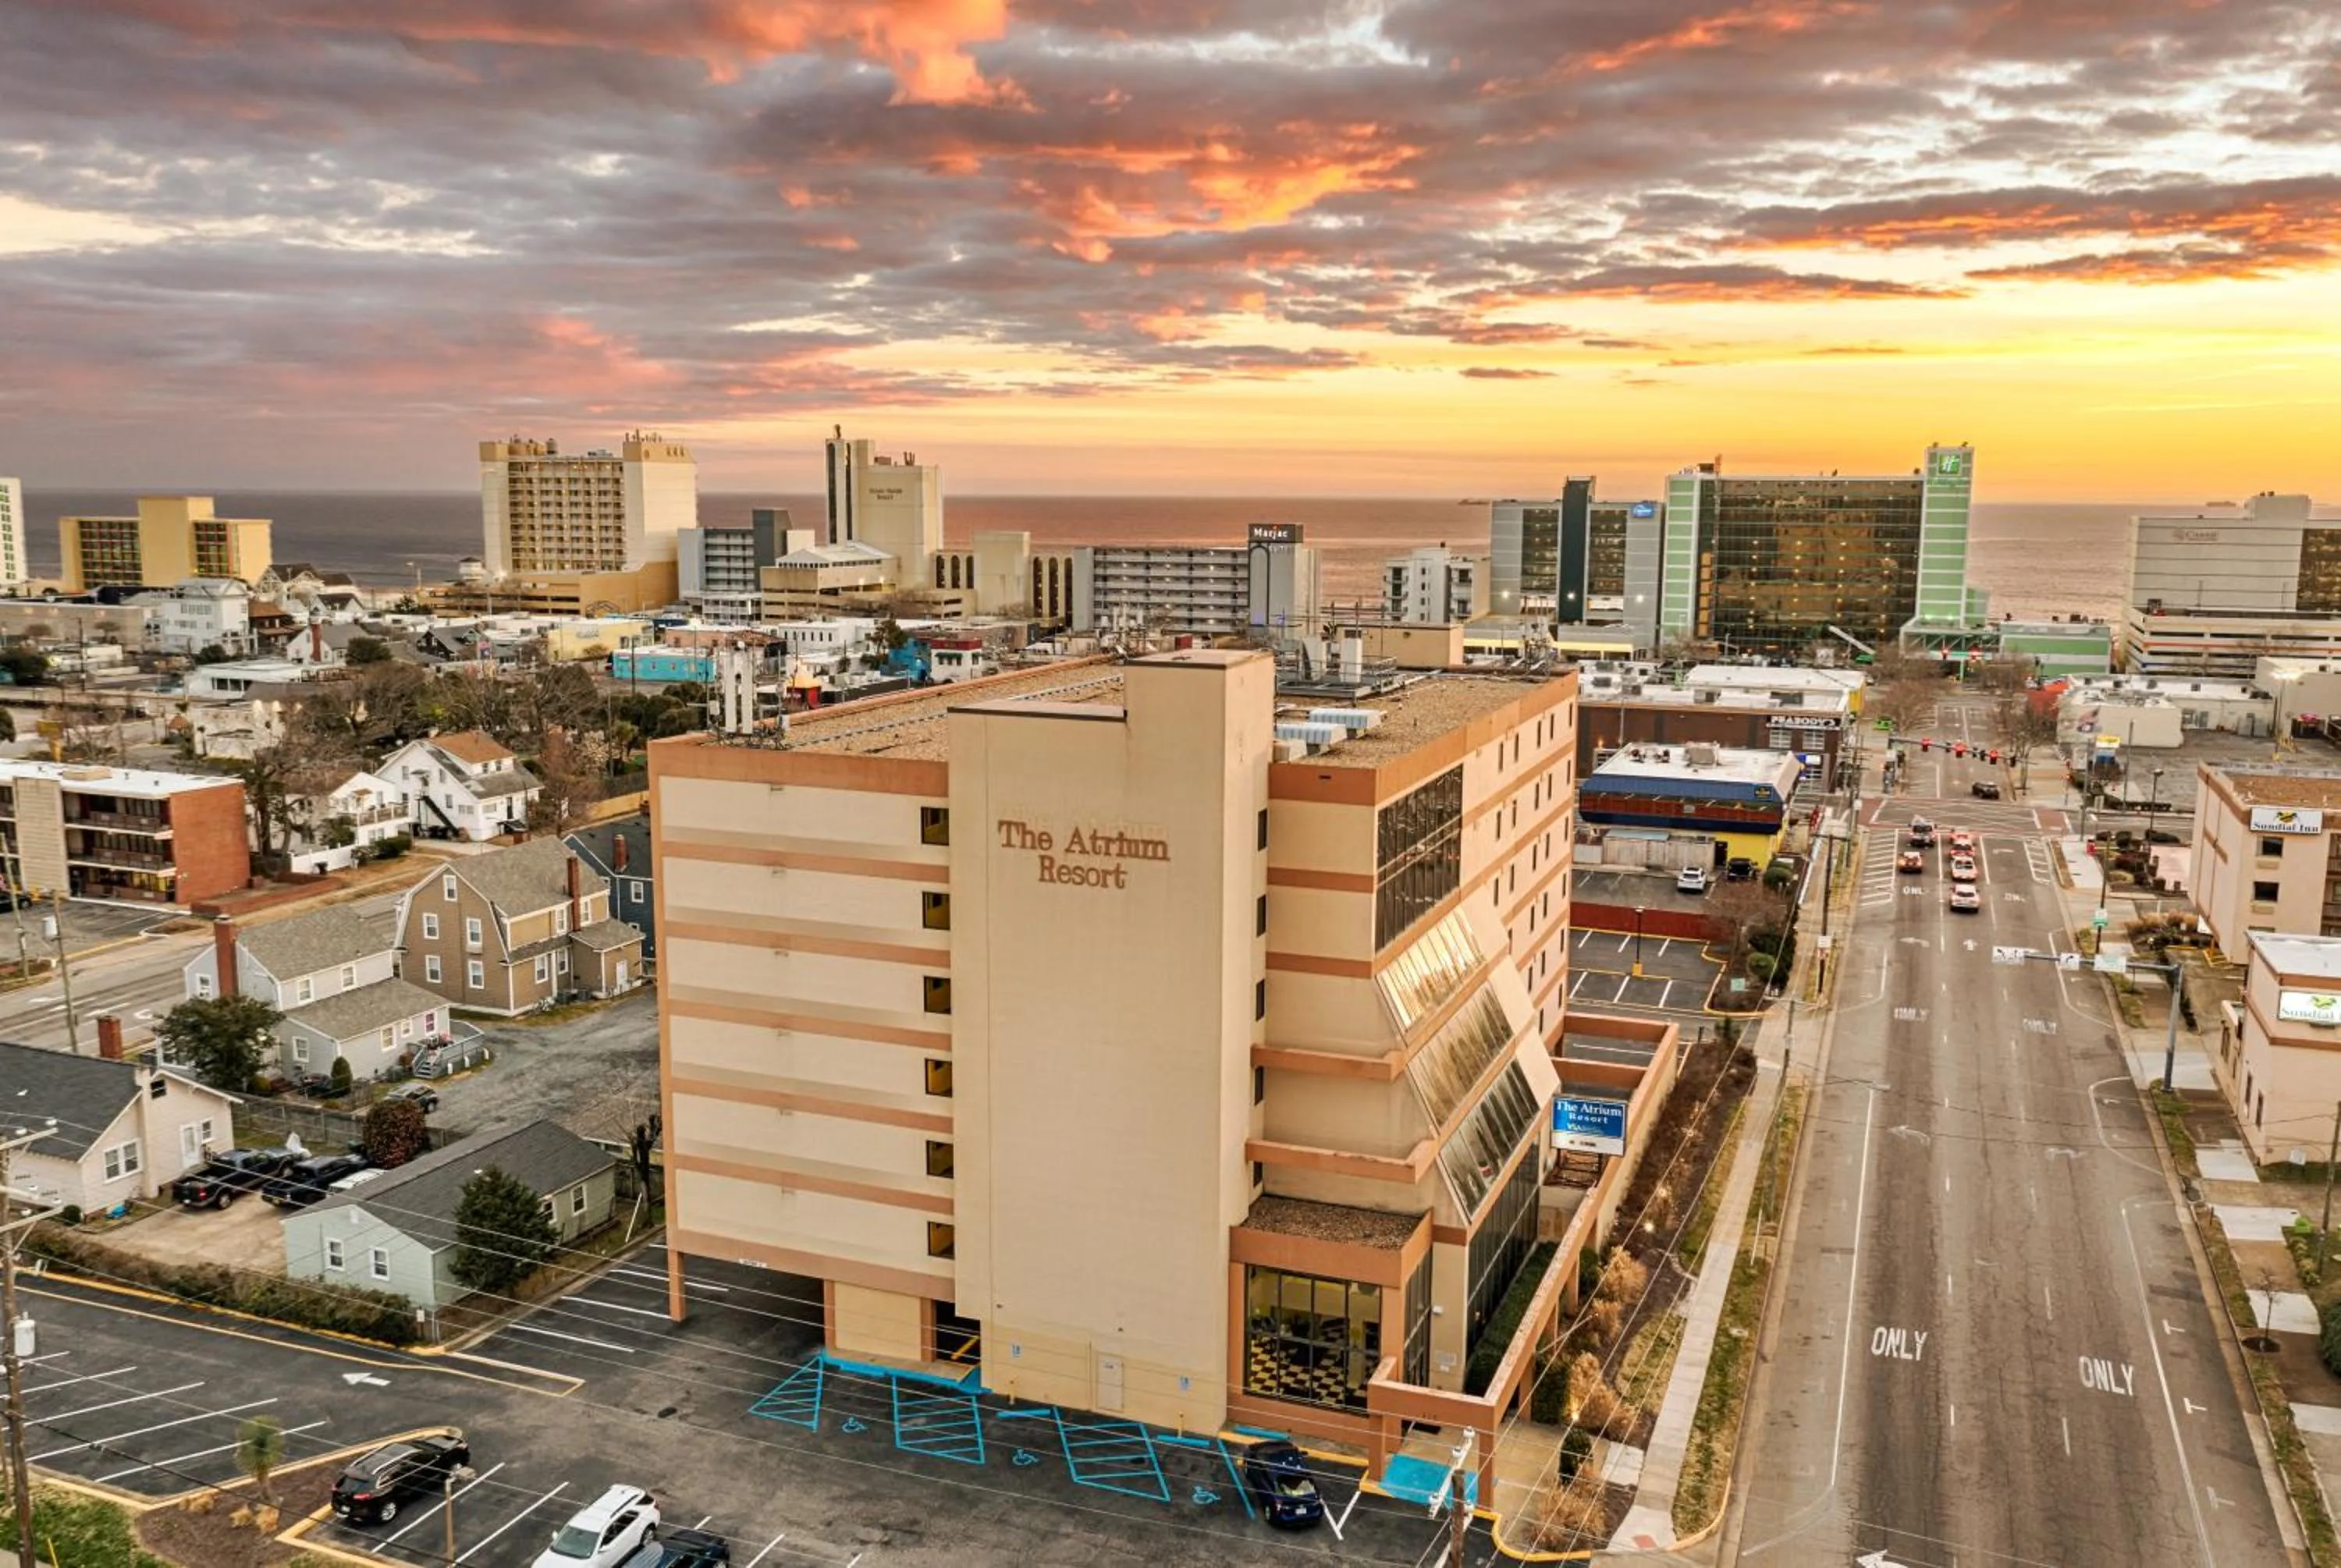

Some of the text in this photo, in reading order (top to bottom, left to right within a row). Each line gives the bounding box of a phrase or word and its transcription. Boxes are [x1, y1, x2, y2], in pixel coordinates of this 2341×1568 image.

[1254, 525, 1288, 539] Marjac
[2253, 822, 2318, 832] Sundial Inn
[998, 820, 1171, 861] The Atrium
[1038, 855, 1128, 889] Resort
[2282, 1008, 2334, 1019] Sundial
[1557, 1101, 1622, 1116] The Atrium
[1568, 1112, 1608, 1123] Resort
[1871, 1326, 1927, 1360] ONLY
[2079, 1356, 2135, 1396] ONLY
